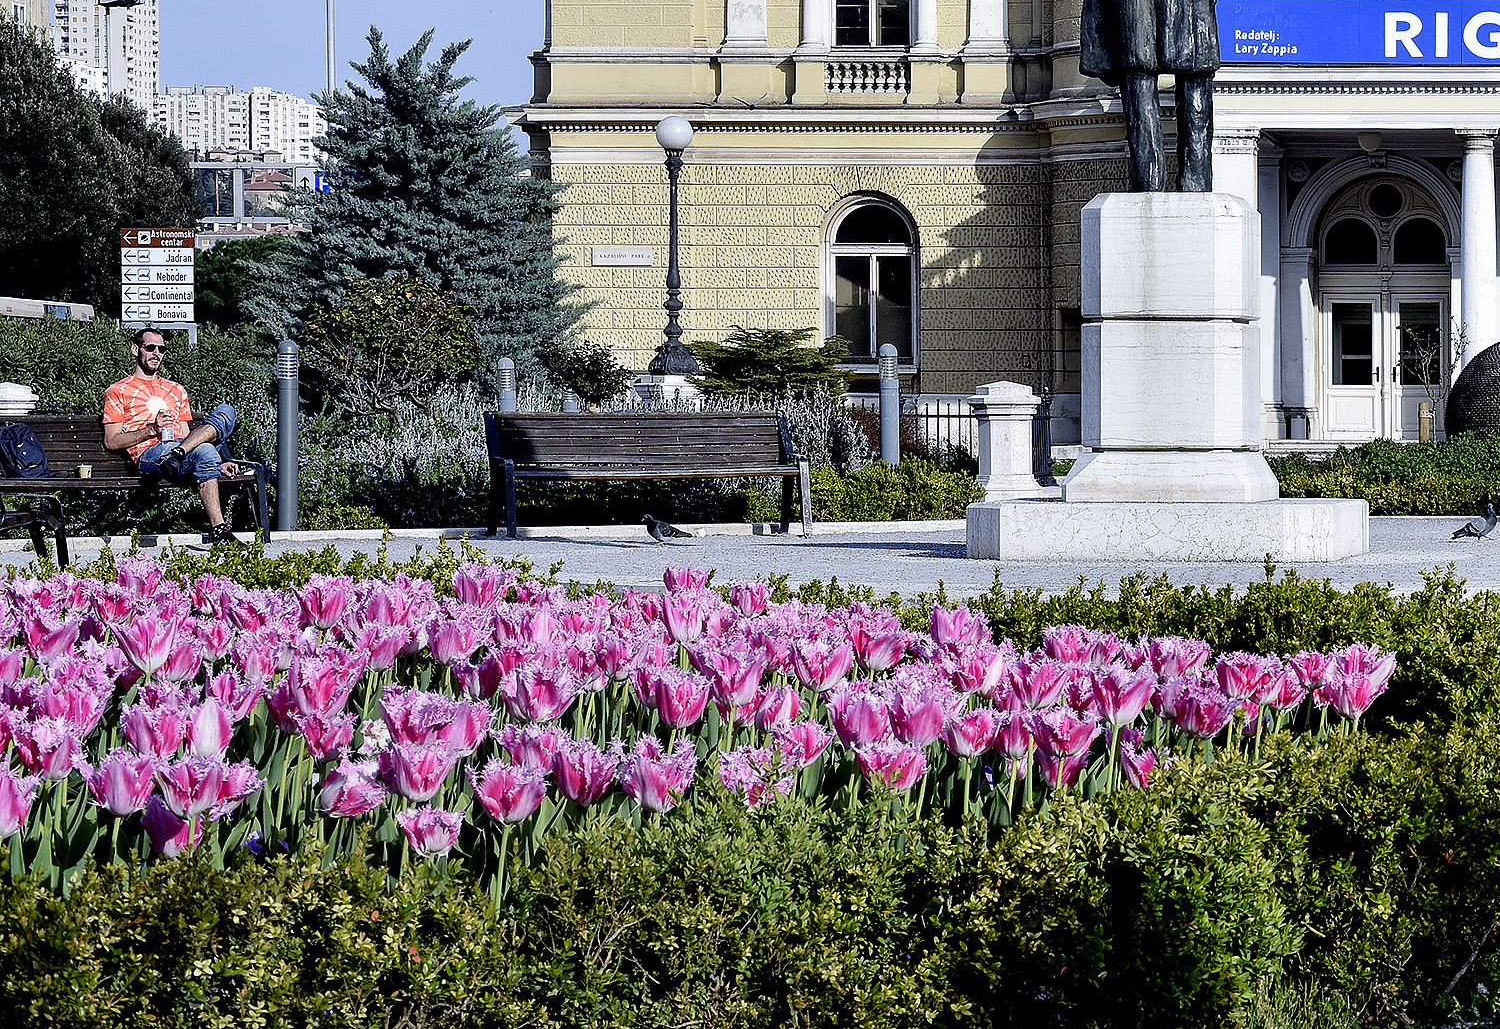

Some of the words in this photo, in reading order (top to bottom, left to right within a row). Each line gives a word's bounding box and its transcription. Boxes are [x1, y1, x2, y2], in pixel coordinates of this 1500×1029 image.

[1235, 29, 1280, 43] Redatelj:
[1235, 42, 1259, 56] Lary
[1260, 42, 1298, 56] Zappia
[150, 230, 195, 238] Astronomski
[165, 253, 193, 263] Jadran
[156, 272, 187, 282] Neboder
[151, 290, 194, 301] Continental
[157, 309, 187, 319] Bonavia
